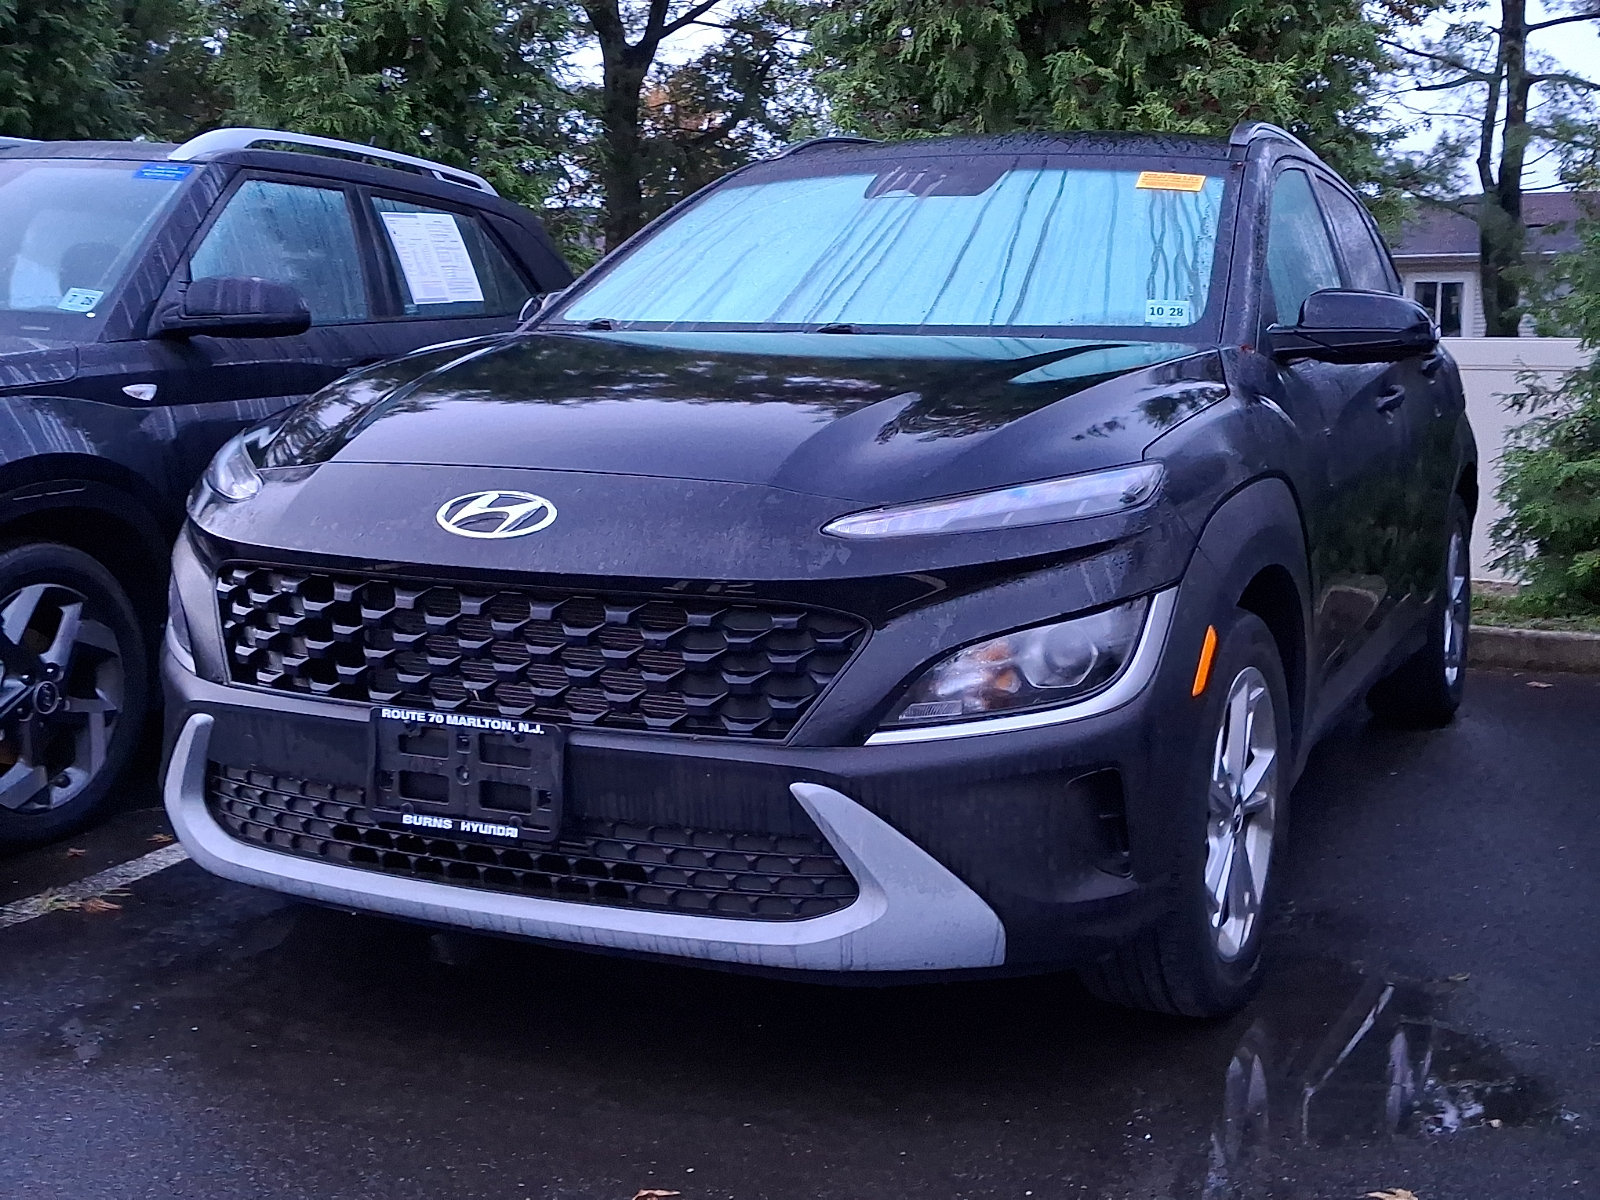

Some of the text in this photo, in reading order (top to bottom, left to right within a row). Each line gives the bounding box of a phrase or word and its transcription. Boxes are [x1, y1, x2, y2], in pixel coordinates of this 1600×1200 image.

[1150, 306, 1184, 317] 10 28
[381, 708, 545, 734] ROUTE 70 MARLTON, N.J.
[402, 814, 518, 838] BURNS HYUNDAI
